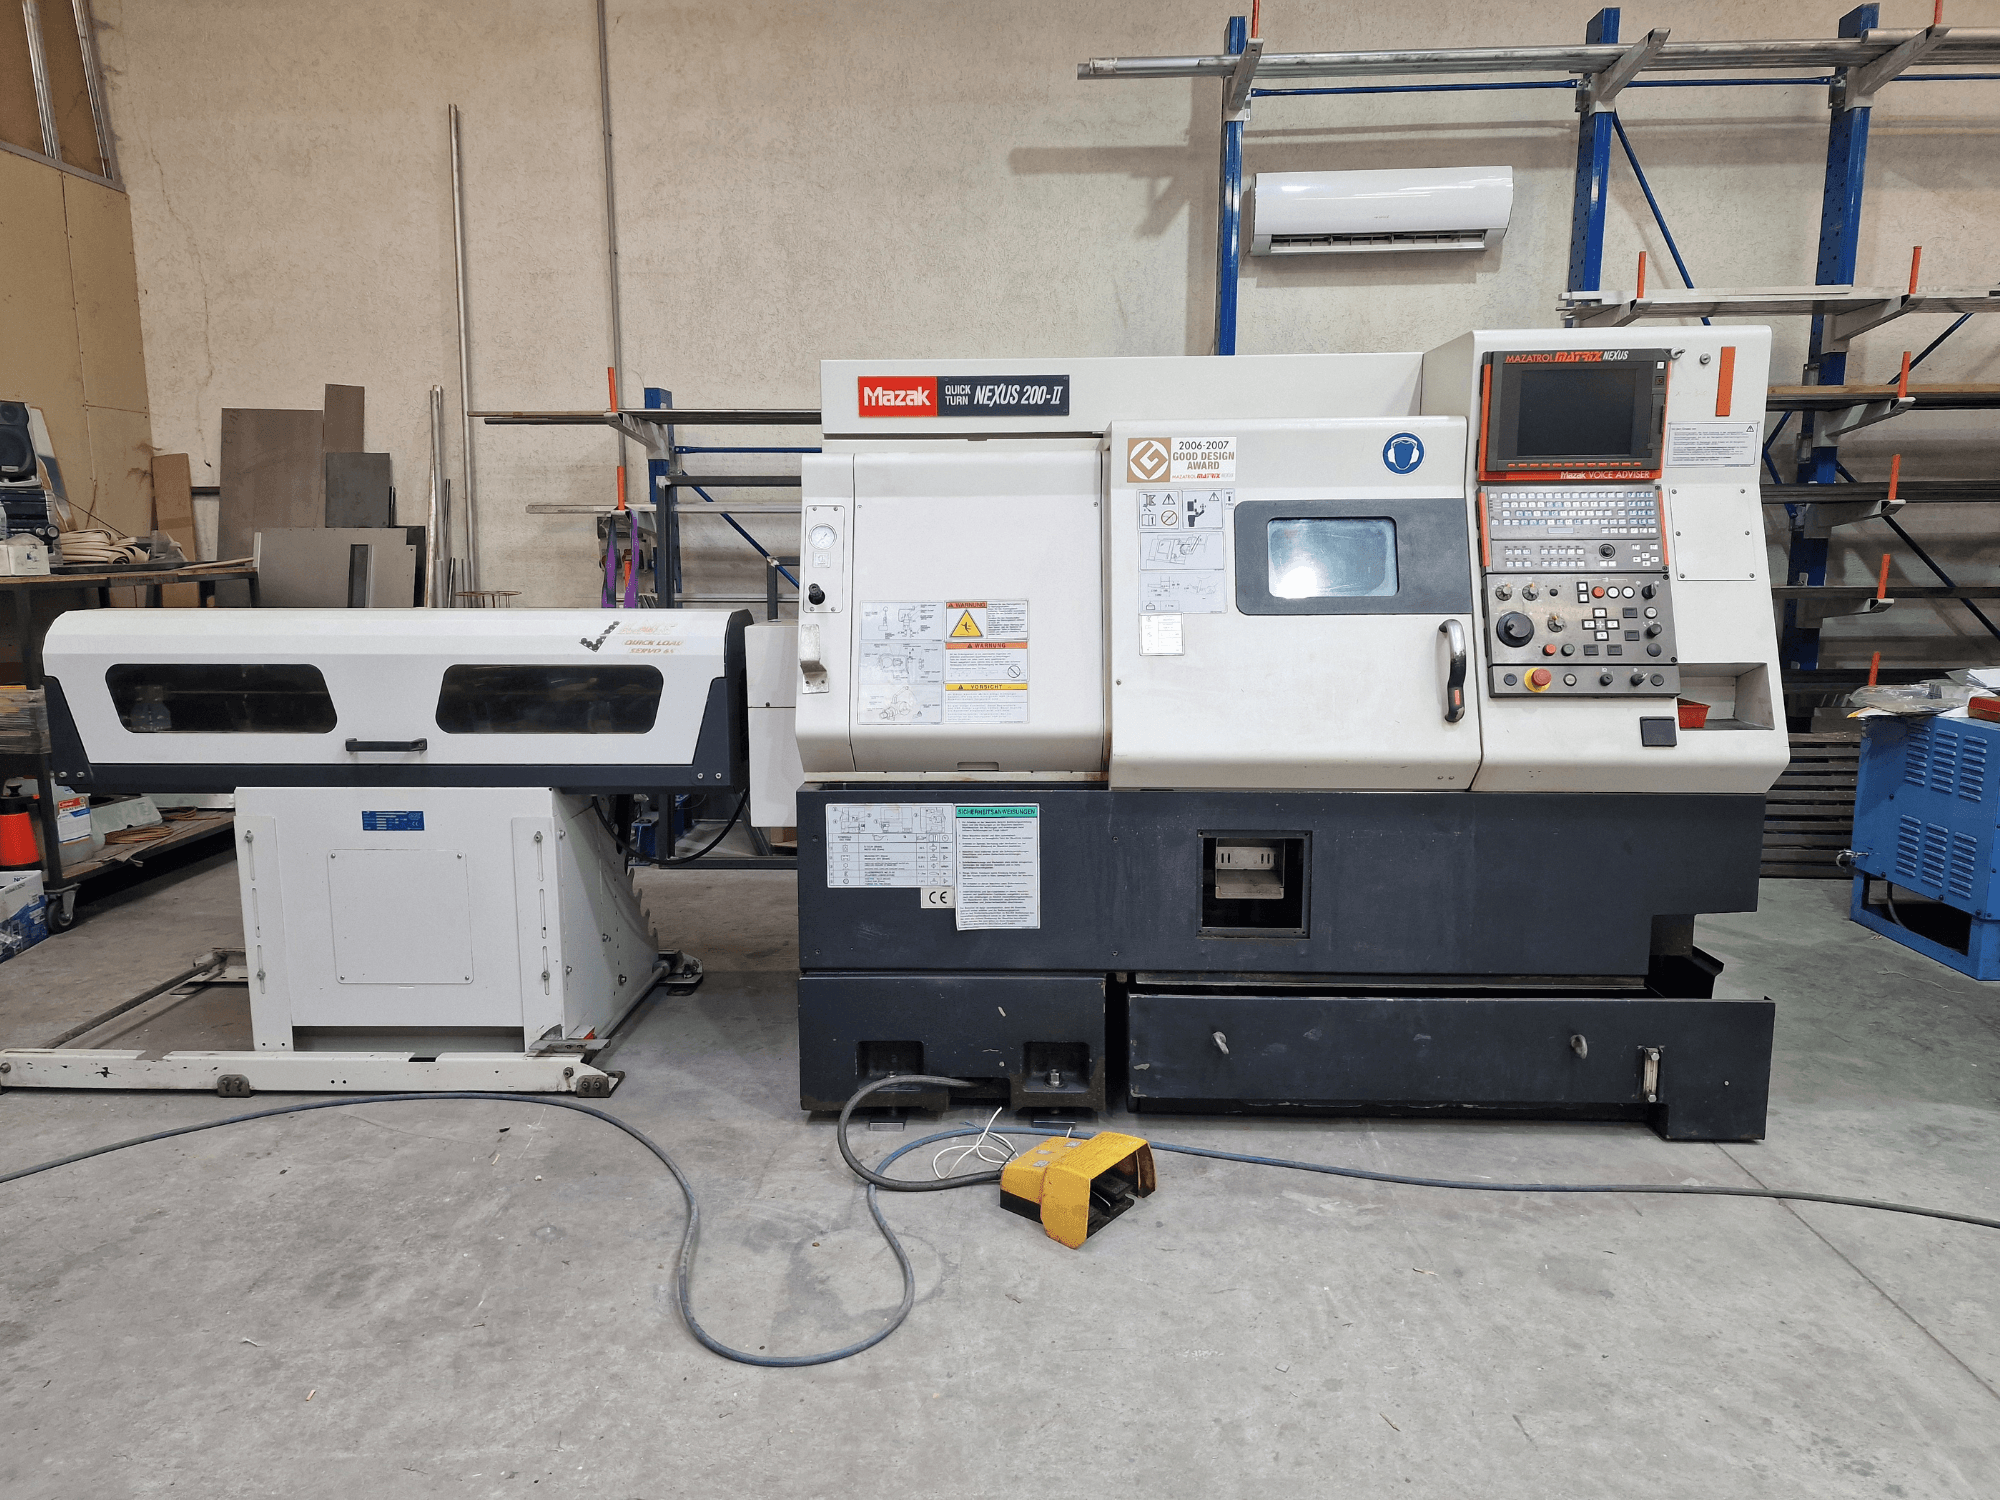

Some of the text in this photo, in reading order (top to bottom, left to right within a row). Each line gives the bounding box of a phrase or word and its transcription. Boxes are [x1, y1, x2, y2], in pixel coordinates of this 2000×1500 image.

[1505, 350, 1629, 363] MAZATROL MATRIX NEXUS
[945, 384, 971, 395] QUICK
[973, 383, 1020, 407] NEXUS
[863, 386, 931, 406] Mazak
[945, 395, 969, 405] TURN
[1178, 440, 1229, 450] 2006-2007
[1172, 452, 1234, 460] GOOD DESIGN
[1560, 470, 1650, 479] Mazak VOICE ADVISER
[928, 891, 948, 904] CE
